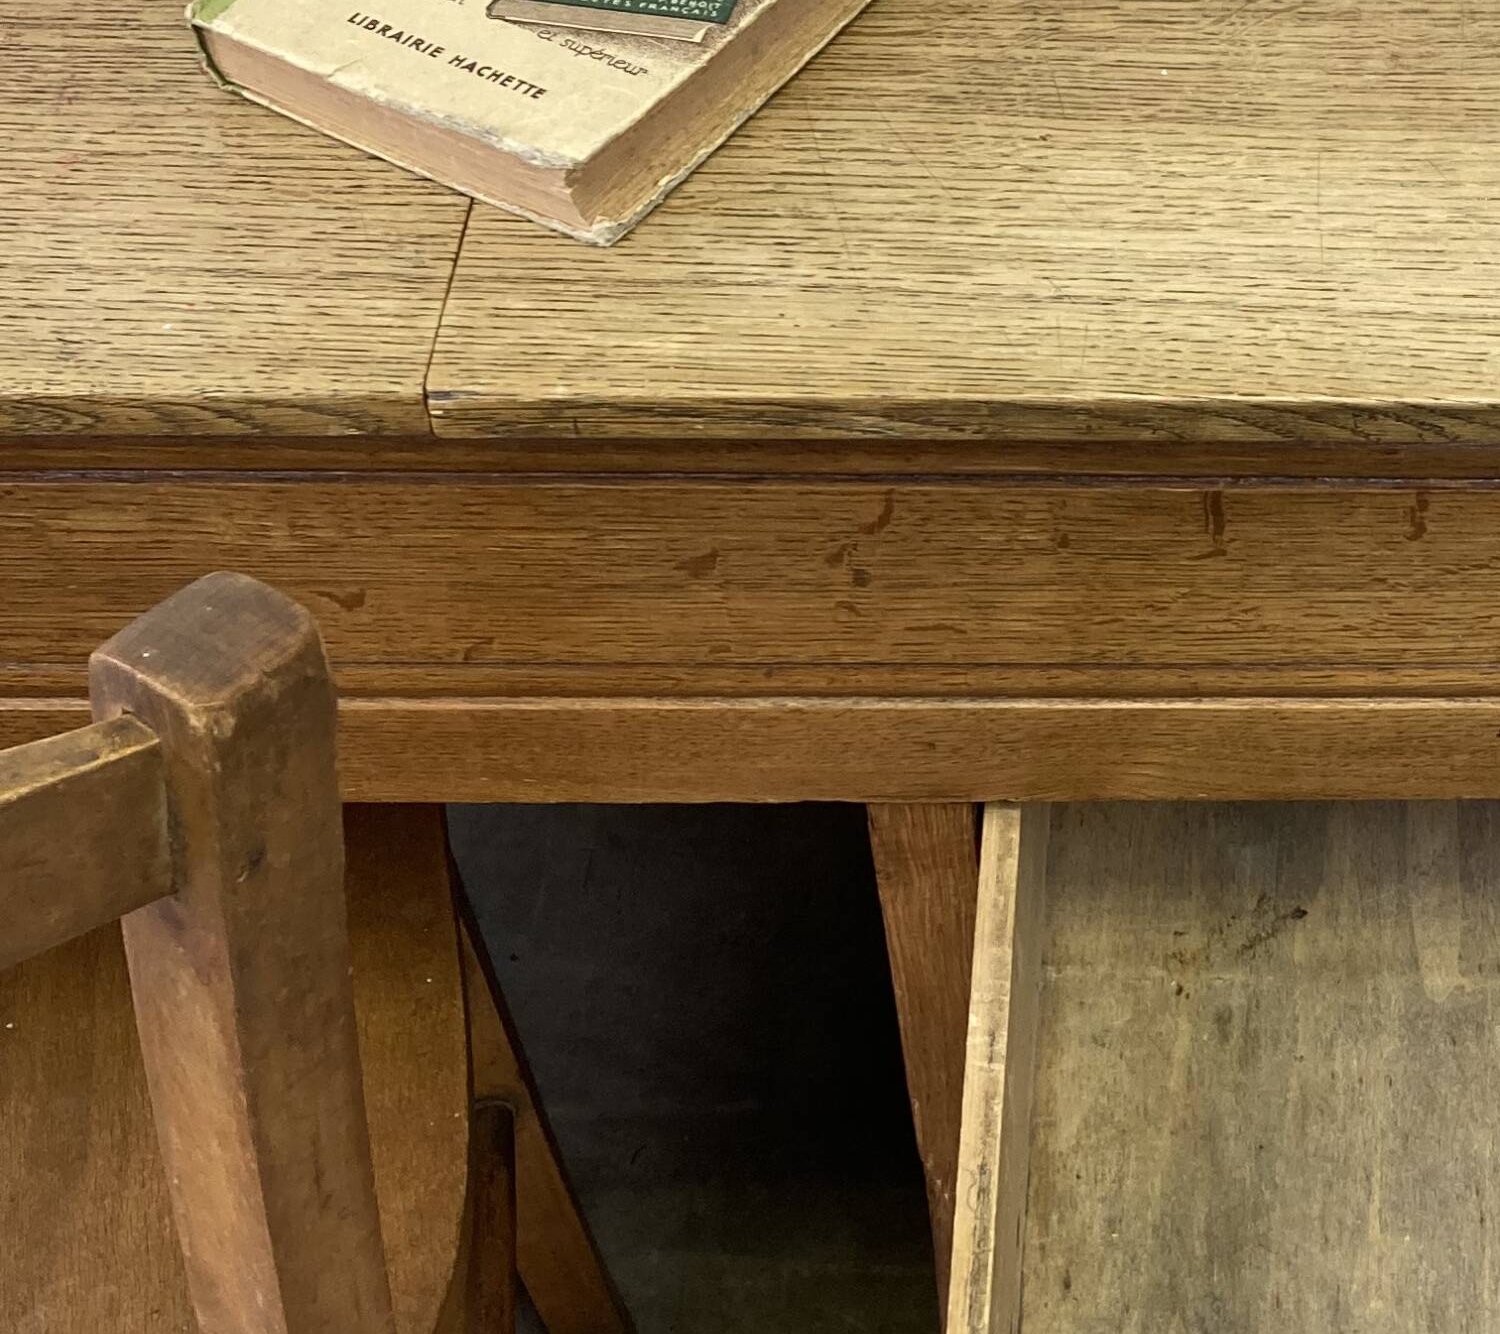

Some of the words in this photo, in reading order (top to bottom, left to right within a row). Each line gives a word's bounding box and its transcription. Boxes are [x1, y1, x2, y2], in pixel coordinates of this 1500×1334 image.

[346, 12, 445, 58] LIBRAIRIE
[447, 54, 548, 100] HACHETTE
[558, 38, 650, 77] supérieur
